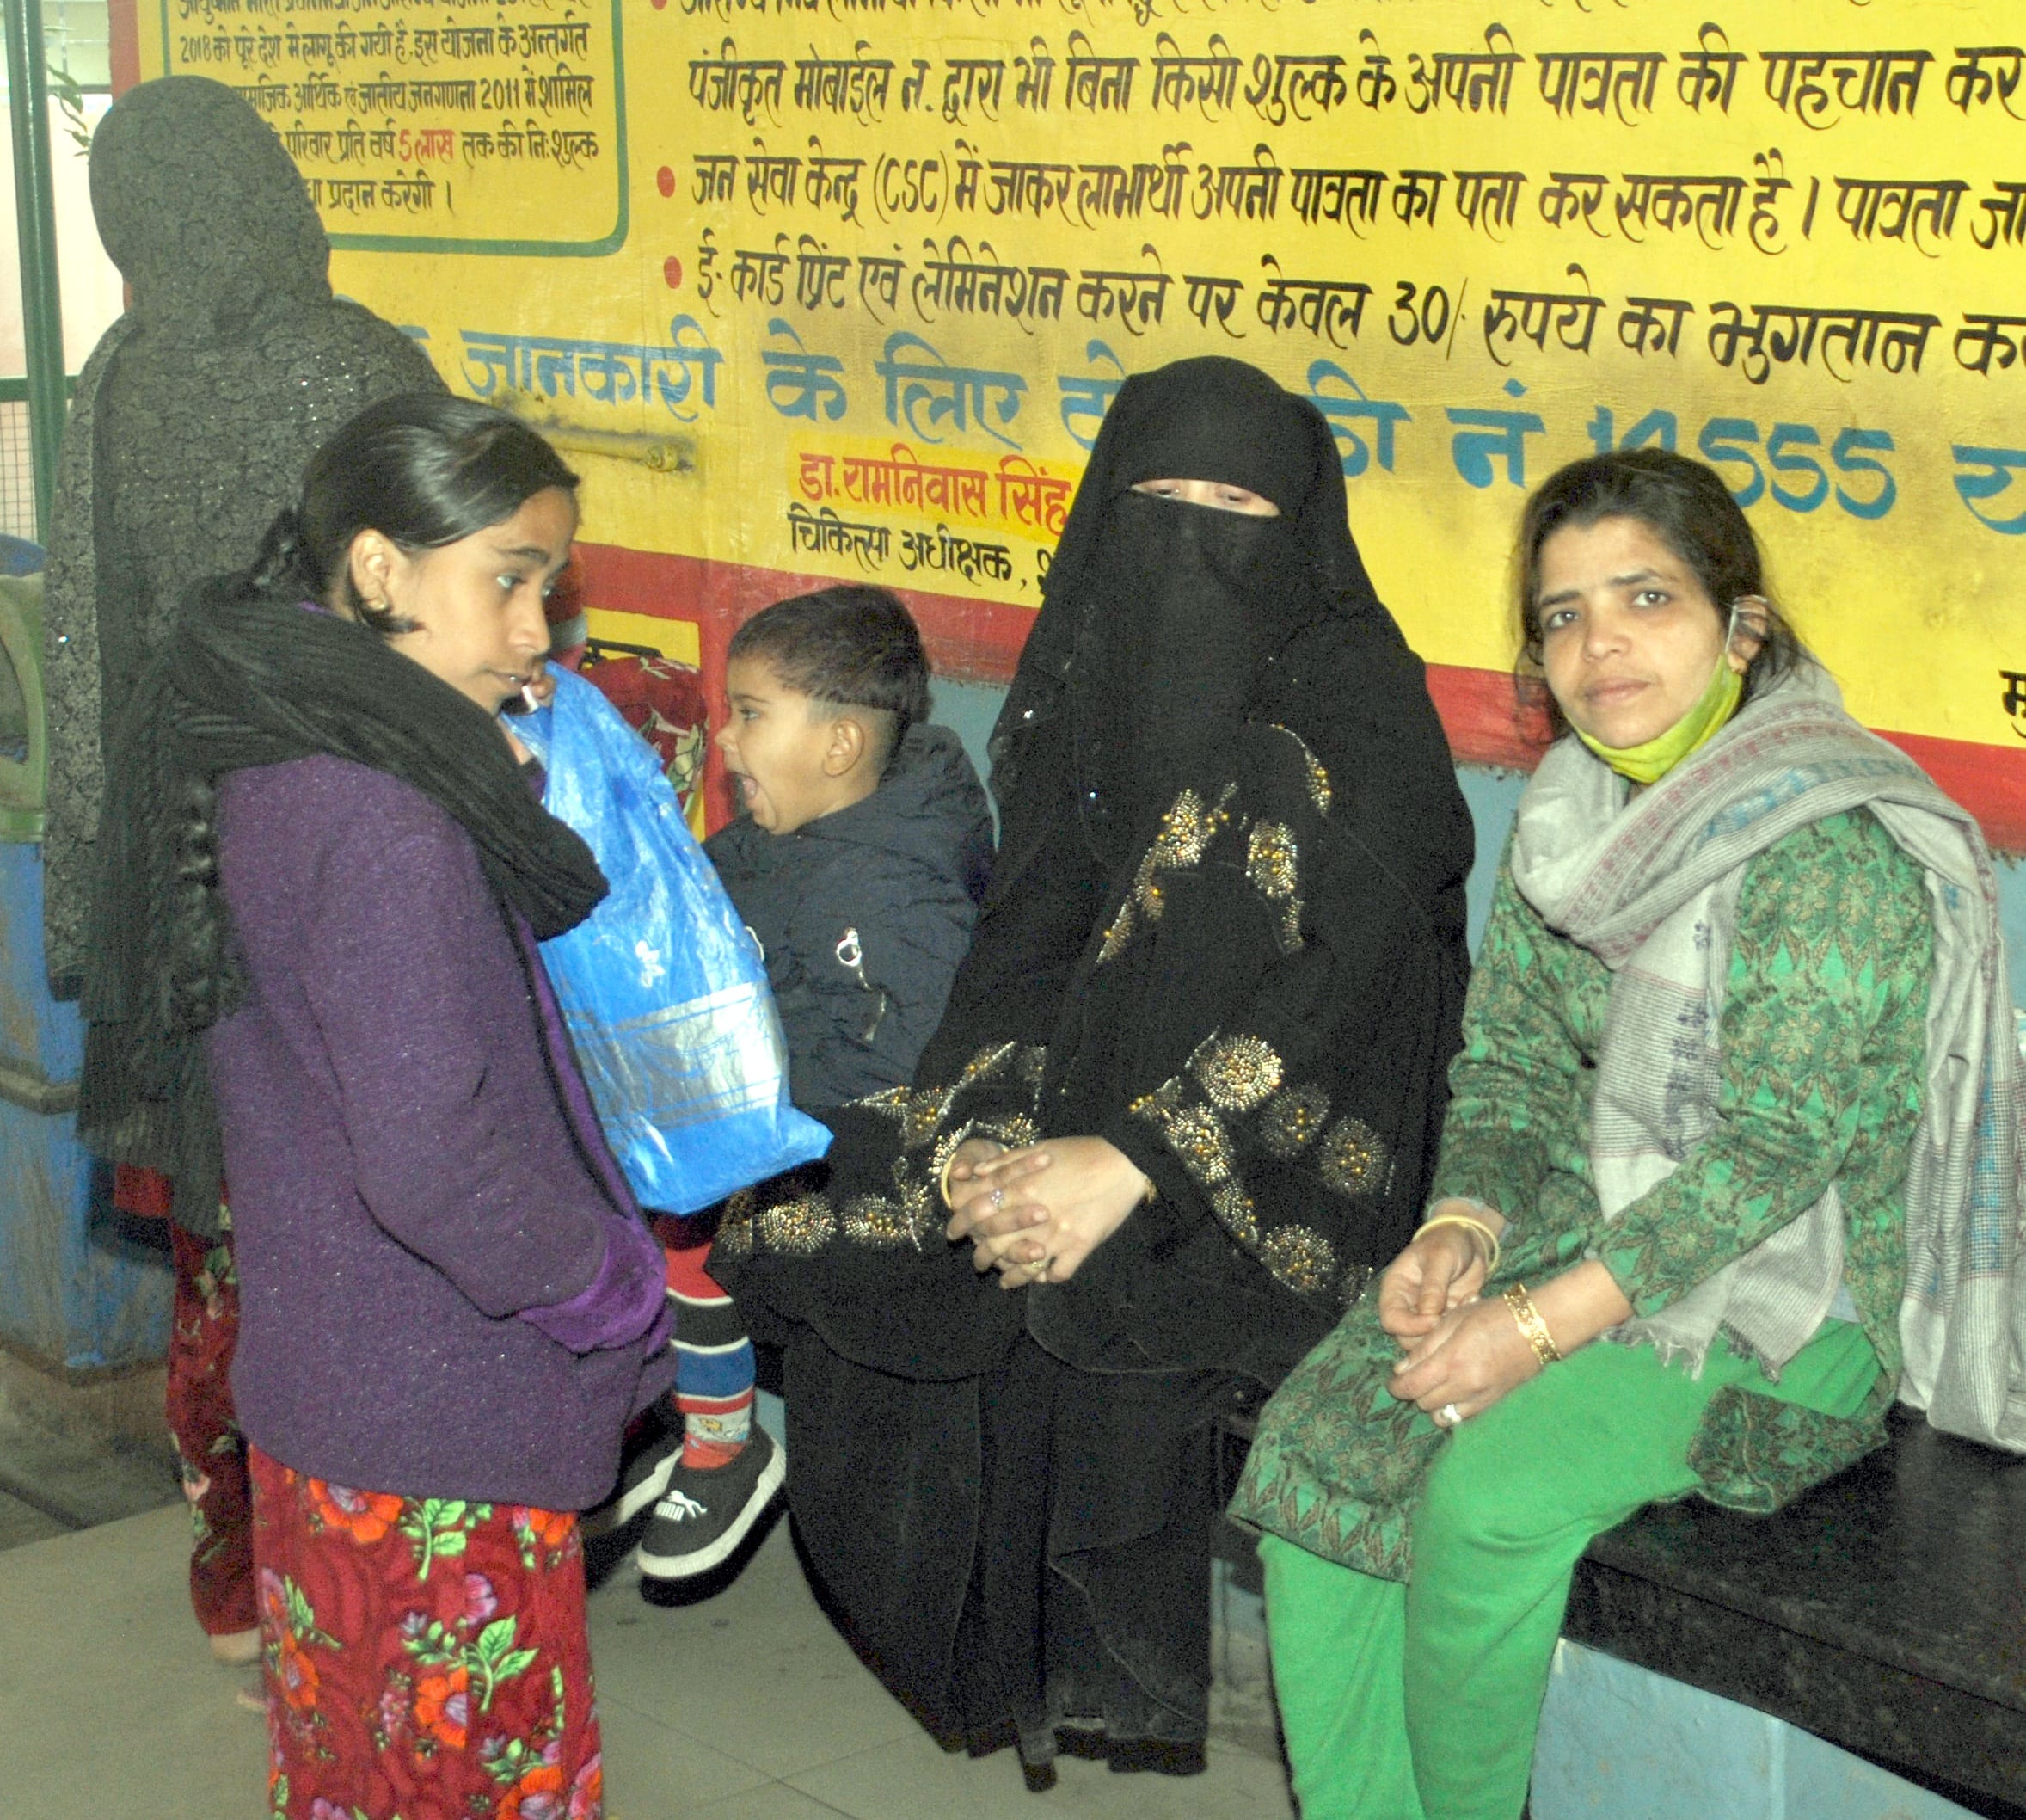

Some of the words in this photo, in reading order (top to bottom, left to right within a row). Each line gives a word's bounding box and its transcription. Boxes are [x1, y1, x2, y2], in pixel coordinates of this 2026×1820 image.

[179, 35, 212, 64] 2018
[213, 24, 232, 63] को
[335, 20, 358, 59] की
[440, 15, 495, 60] योजना
[497, 11, 516, 58] के
[688, 37, 787, 128] पंजीकृत
[942, 57, 1005, 126] द्वारा
[1014, 35, 1056, 111] भी
[1065, 29, 1141, 114] बिना
[1151, 32, 1244, 123] किसी
[1244, 53, 1348, 126] शुल्क
[1356, 28, 1396, 113] के
[1404, 22, 1526, 117] अपनी
[1533, 51, 1669, 127] पात्रता
[1677, 22, 1749, 120] की
[1758, 48, 1937, 130] पहचान
[479, 77, 520, 110] 2011
[522, 65, 537, 108] में
[538, 62, 595, 117] शामिल
[285, 120, 339, 164] परिवार
[336, 118, 366, 166] प्रति
[399, 128, 413, 162] 5
[414, 128, 455, 166] लाख
[460, 131, 495, 169] तक
[496, 119, 525, 160] की
[327, 180, 378, 216] प्रदान
[381, 169, 437, 214] करेगी
[691, 153, 740, 206] जन
[745, 136, 804, 216] सेवा
[804, 135, 867, 228] केन्द्र
[873, 151, 950, 225] (CSC)
[953, 138, 984, 214] में
[981, 158, 1081, 227] जाकर
[1191, 142, 1286, 220] अपनी
[1289, 168, 1390, 240] पात्रता
[1391, 169, 1449, 228] का
[1452, 170, 1528, 243] पता
[1538, 171, 1612, 238] कर
[1615, 172, 1749, 250] सकता
[1747, 147, 1794, 255] है
[1833, 175, 1973, 258] पात्रता
[796, 233, 852, 312] प्रिंट
[857, 243, 908, 325] एवं
[912, 235, 1072, 335] लेमिनेशन
[1076, 243, 1175, 336] करने
[1182, 274, 1246, 339] पर
[1256, 253, 1374, 350] केवल
[1484, 262, 1607, 367] रुपये
[1617, 296, 1696, 358] का
[1707, 301, 1943, 386] भुगतान
[457, 313, 725, 422] जानकारी
[761, 317, 849, 423] के
[875, 330, 1028, 452] लिए
[1444, 378, 1547, 490] नं
[842, 442, 989, 518] रामनिवास
[994, 453, 1073, 537] सिंह
[786, 501, 893, 574] चिकित्सा
